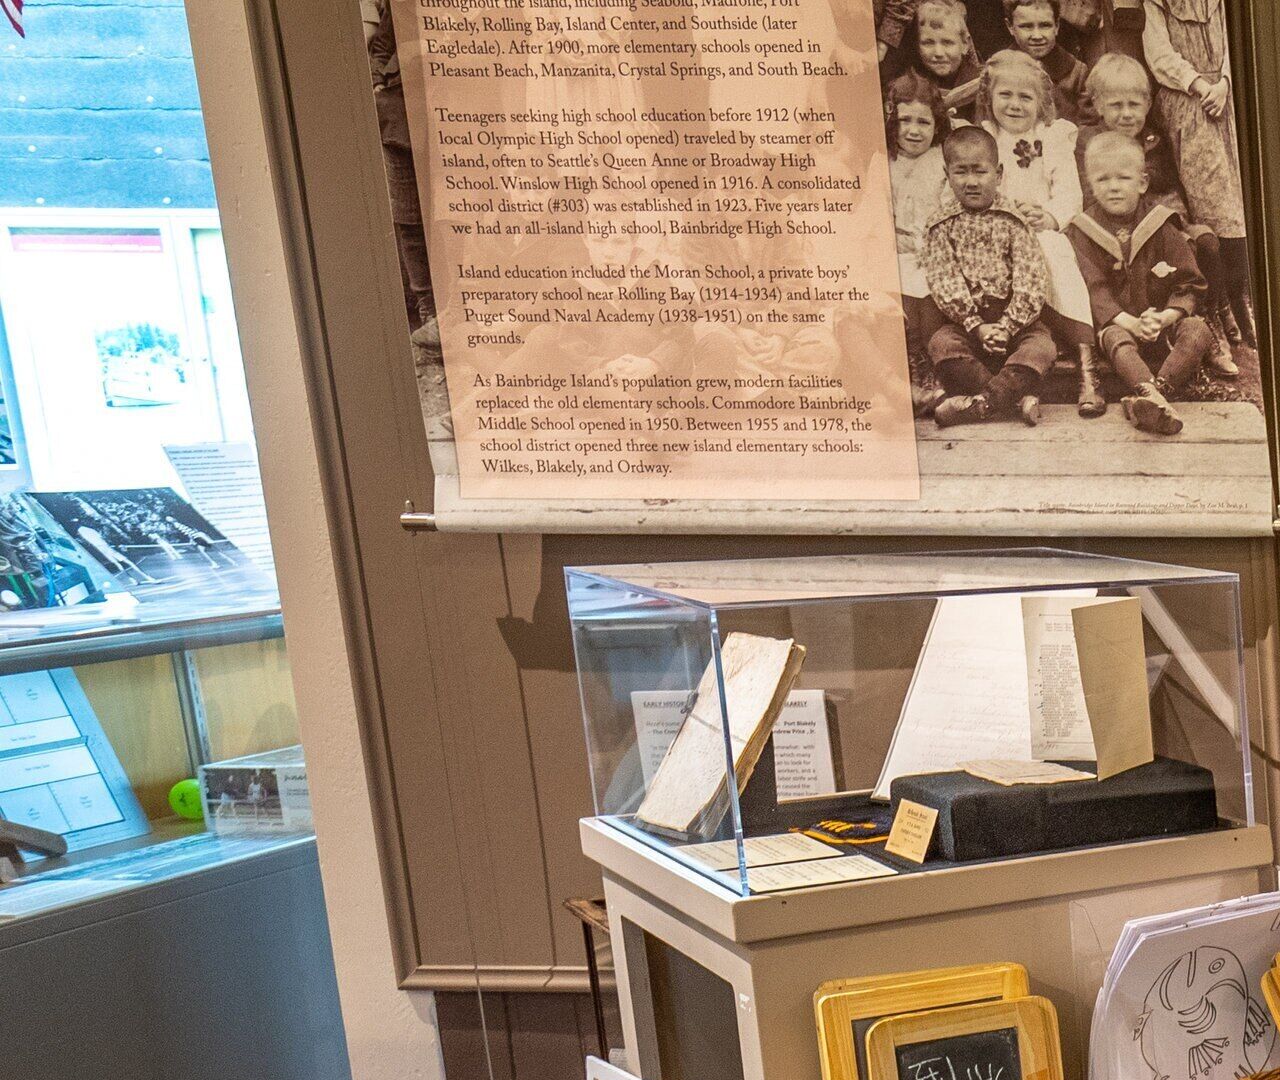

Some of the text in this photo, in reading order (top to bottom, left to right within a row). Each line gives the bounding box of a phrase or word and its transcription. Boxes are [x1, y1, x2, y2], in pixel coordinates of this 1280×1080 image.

[423, 15, 797, 36] Blakely, Rolling Bay, Island Center, and Southside (later
[434, 107, 835, 127] Teenagers seeking high school education before 1912 (when
[446, 175, 861, 194] School. Winslow High School opened in 1916. A consolidated
[458, 264, 850, 283] Island education included the Moran School, a private boys'
[478, 417, 871, 435] Middle School opened in 1950. Between 1955 and 1978, the
